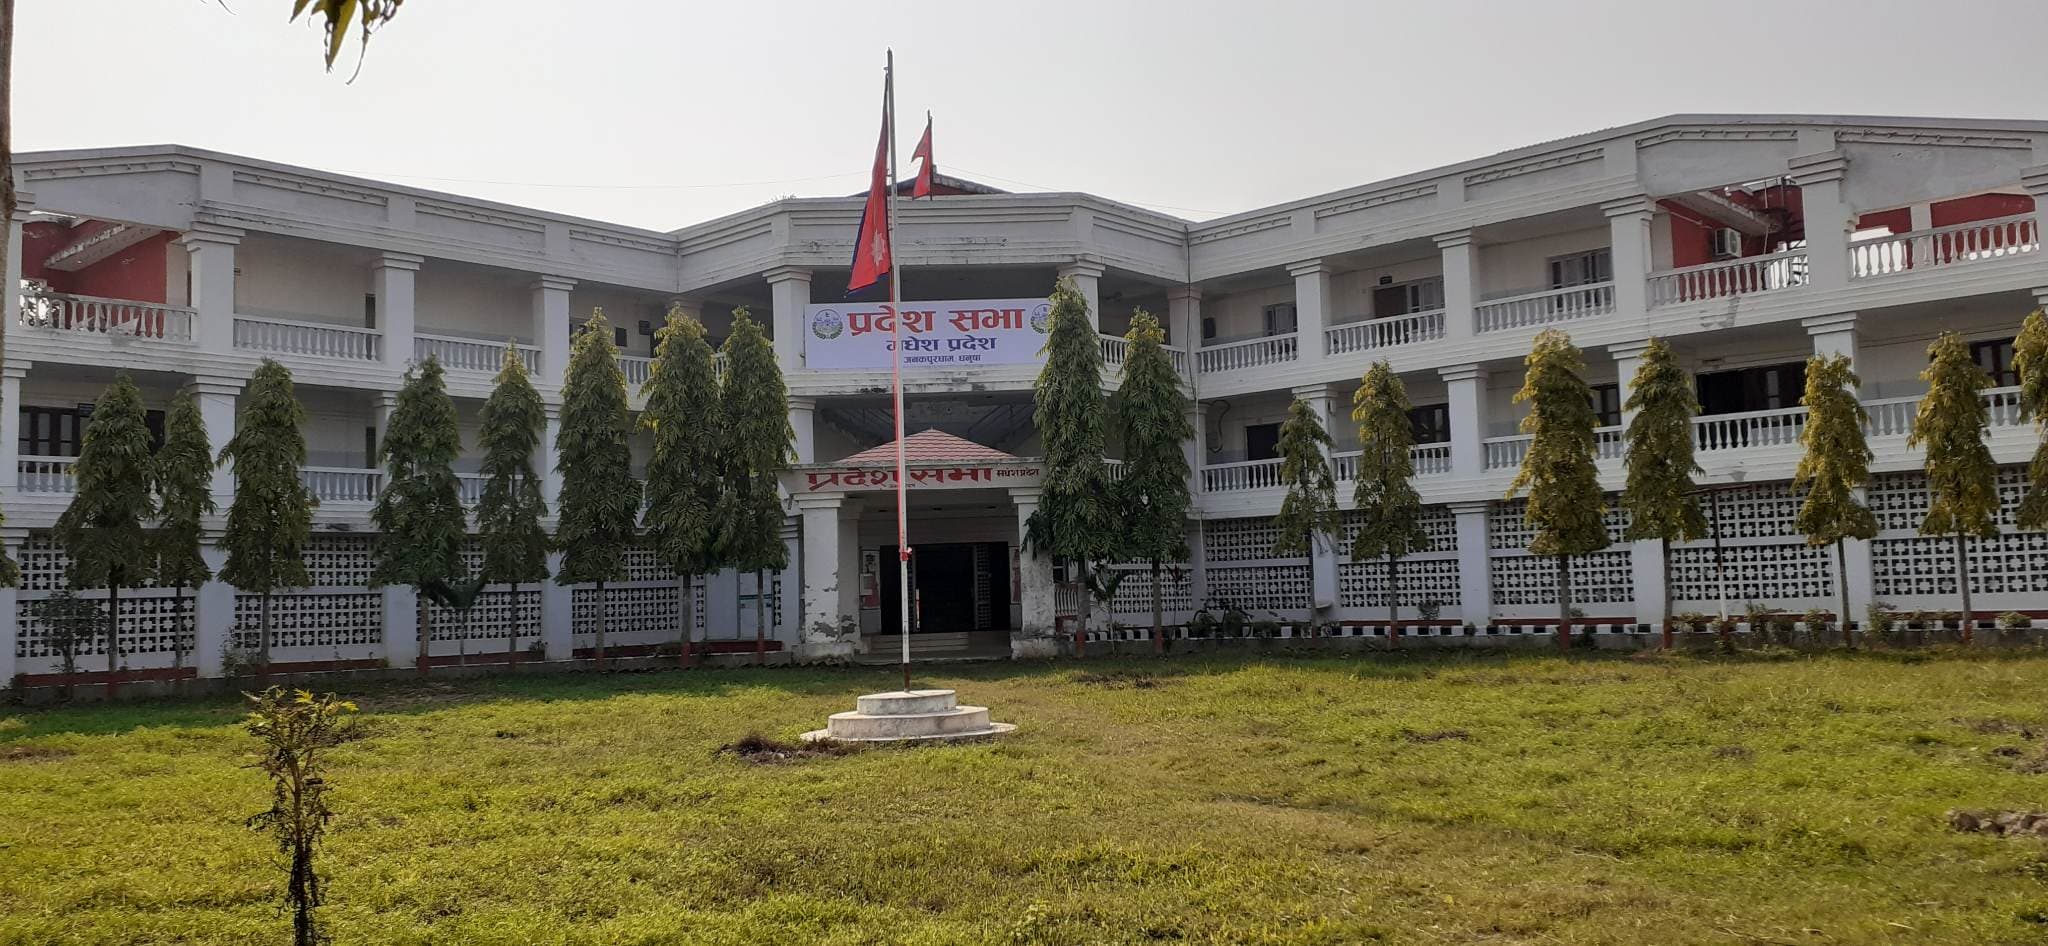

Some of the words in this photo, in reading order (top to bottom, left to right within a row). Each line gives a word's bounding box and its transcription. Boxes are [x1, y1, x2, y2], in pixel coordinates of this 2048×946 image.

[847, 305, 936, 336] प्रदेश
[947, 308, 1026, 332] सभा
[947, 335, 997, 352] प्रदेश
[805, 466, 897, 491] प्रदेश
[910, 467, 993, 485] सभा
